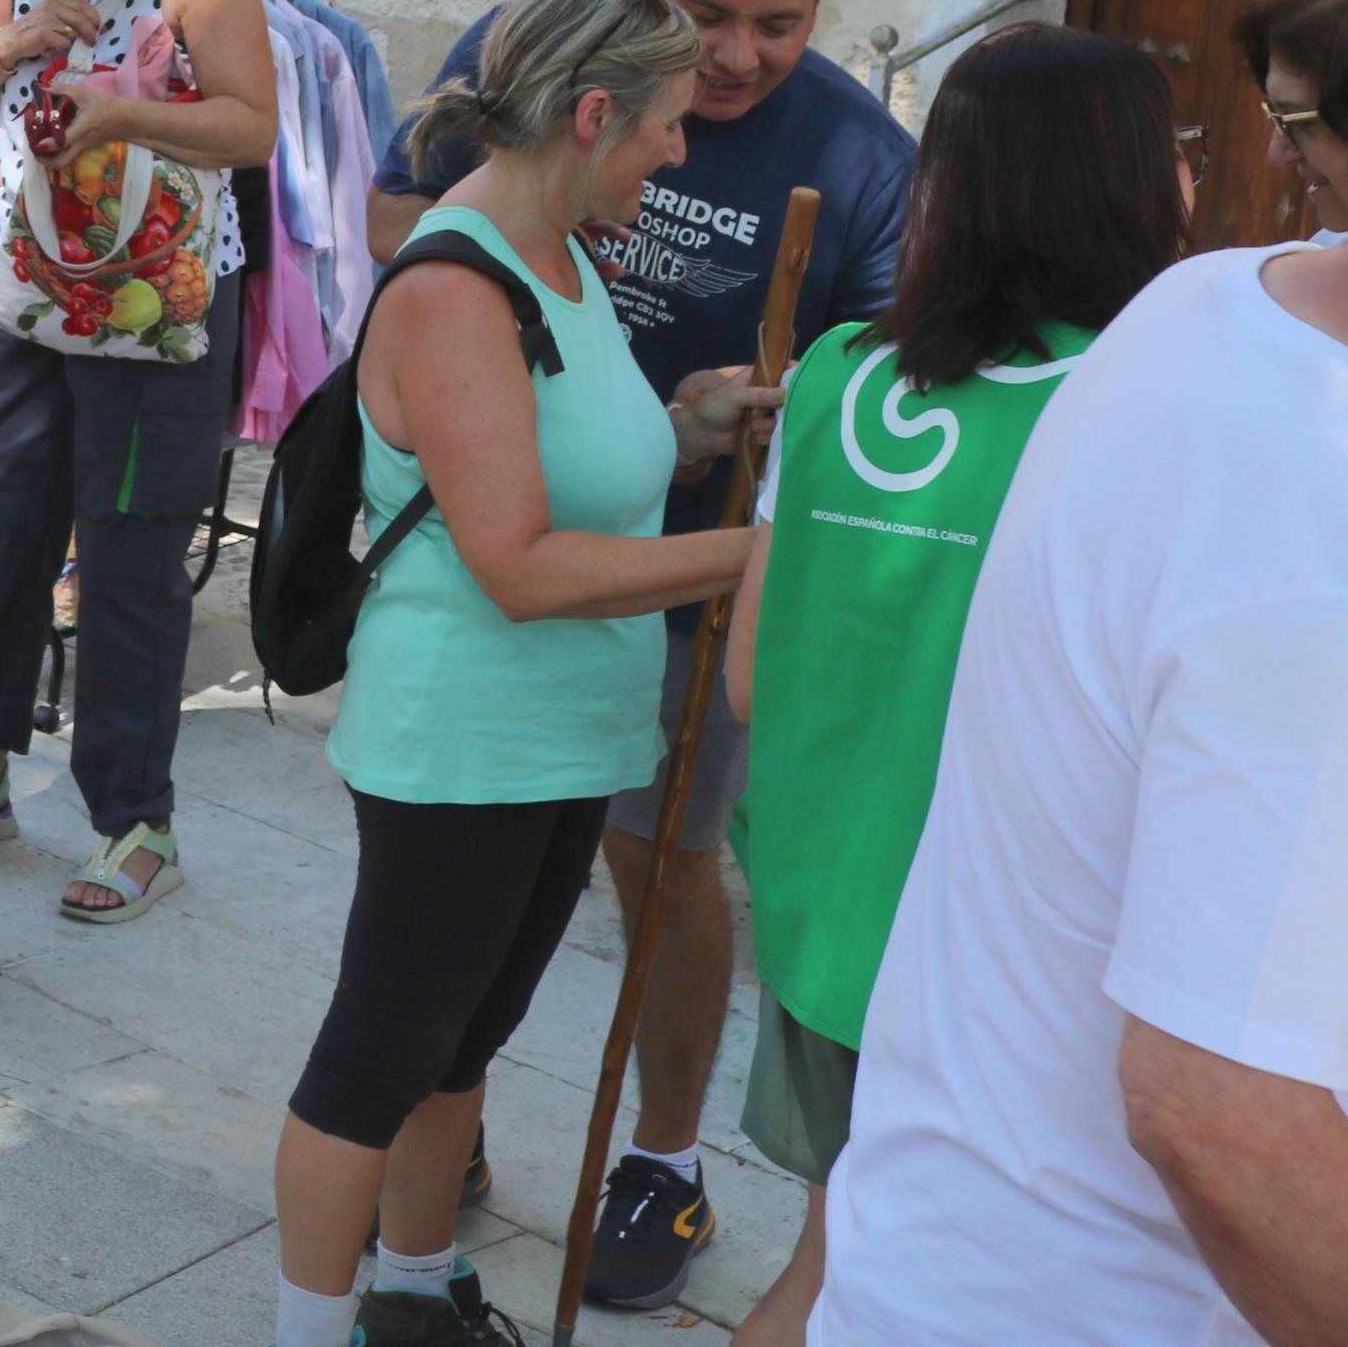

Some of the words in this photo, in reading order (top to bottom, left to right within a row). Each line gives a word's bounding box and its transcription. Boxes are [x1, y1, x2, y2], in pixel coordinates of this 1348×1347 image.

[598, 233, 684, 281] SERVICE
[609, 281, 657, 303] Pembroke
[658, 299, 667, 308] St
[848, 516, 891, 532] ESPAÑOLA
[893, 523, 925, 537] CONTRA
[927, 528, 939, 539] EL
[940, 529, 978, 546] CÁNCER
